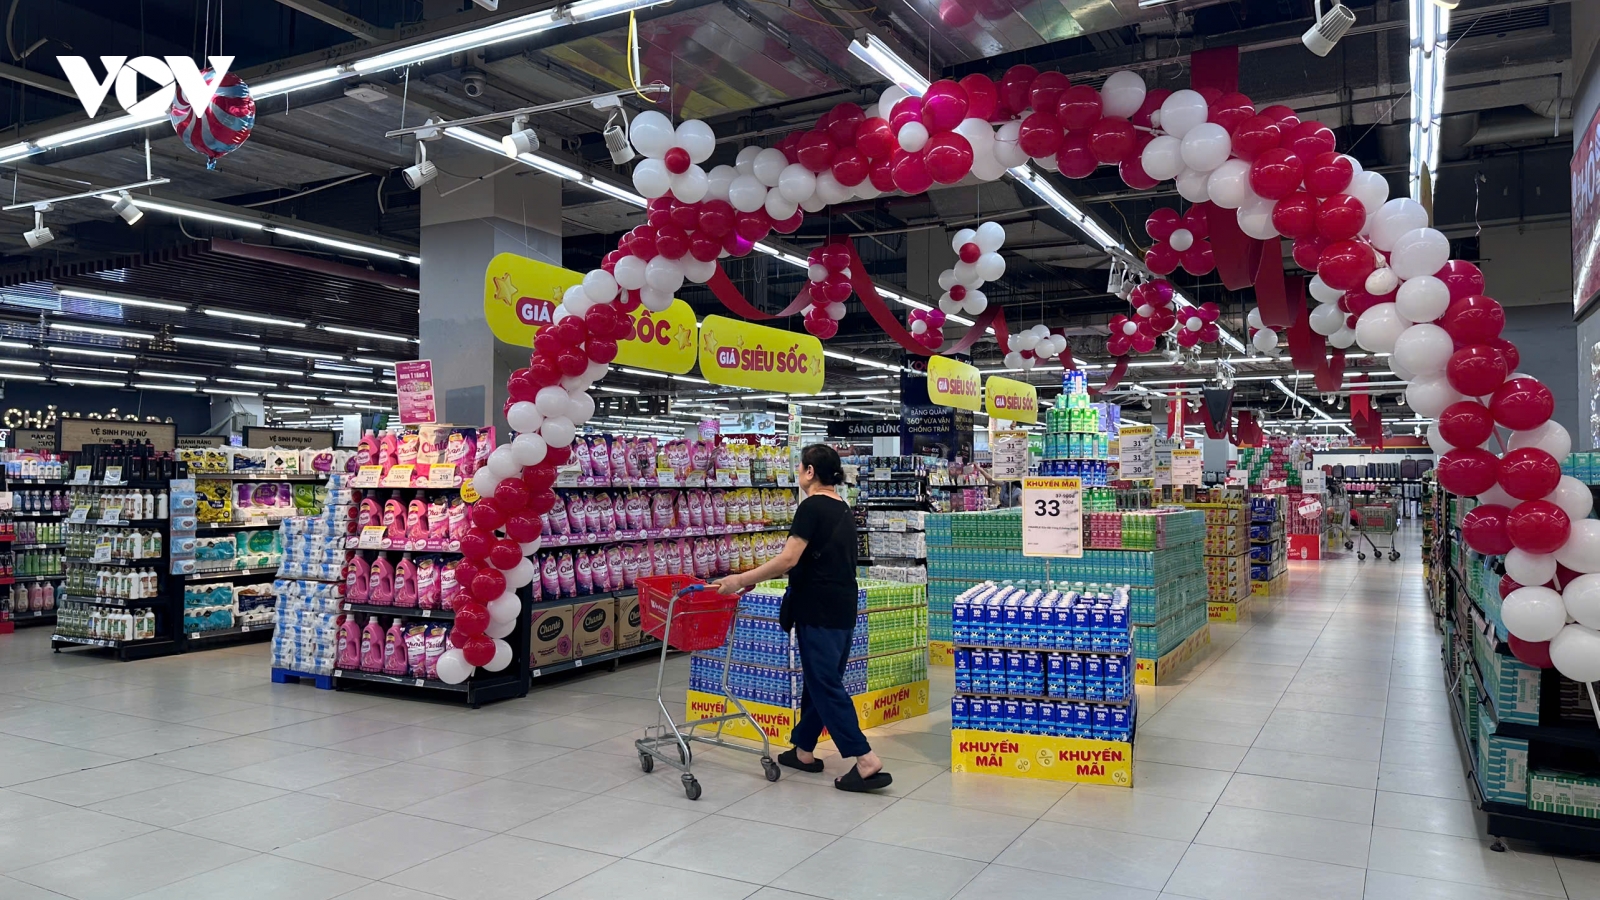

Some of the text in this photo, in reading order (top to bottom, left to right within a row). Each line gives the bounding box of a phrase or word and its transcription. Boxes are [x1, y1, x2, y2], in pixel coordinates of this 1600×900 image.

[521, 300, 551, 323] GIÁ
[719, 343, 808, 374] GIÁ SIÊU SỐC
[938, 375, 977, 397] GIÁ SIÊU SỐC
[995, 391, 1033, 411] GIÁ SIÊU SỐC
[91, 428, 101, 436] VỆ
[121, 430, 135, 438] PHỤ
[849, 424, 874, 434] SÁNG
[1027, 479, 1060, 488] KHUYẾN
[1034, 499, 1060, 517] 33
[585, 611, 604, 625] Chanté
[630, 612, 640, 621] Cha
[539, 620, 561, 634] Chanté
[874, 687, 910, 710] KHUYẾN
[883, 704, 900, 721] MÃI
[959, 739, 1019, 753] KHUYẾN
[976, 754, 1002, 767] MÃI
[1059, 747, 1122, 761] KHUYẾN
[1077, 763, 1105, 775] MÃI
